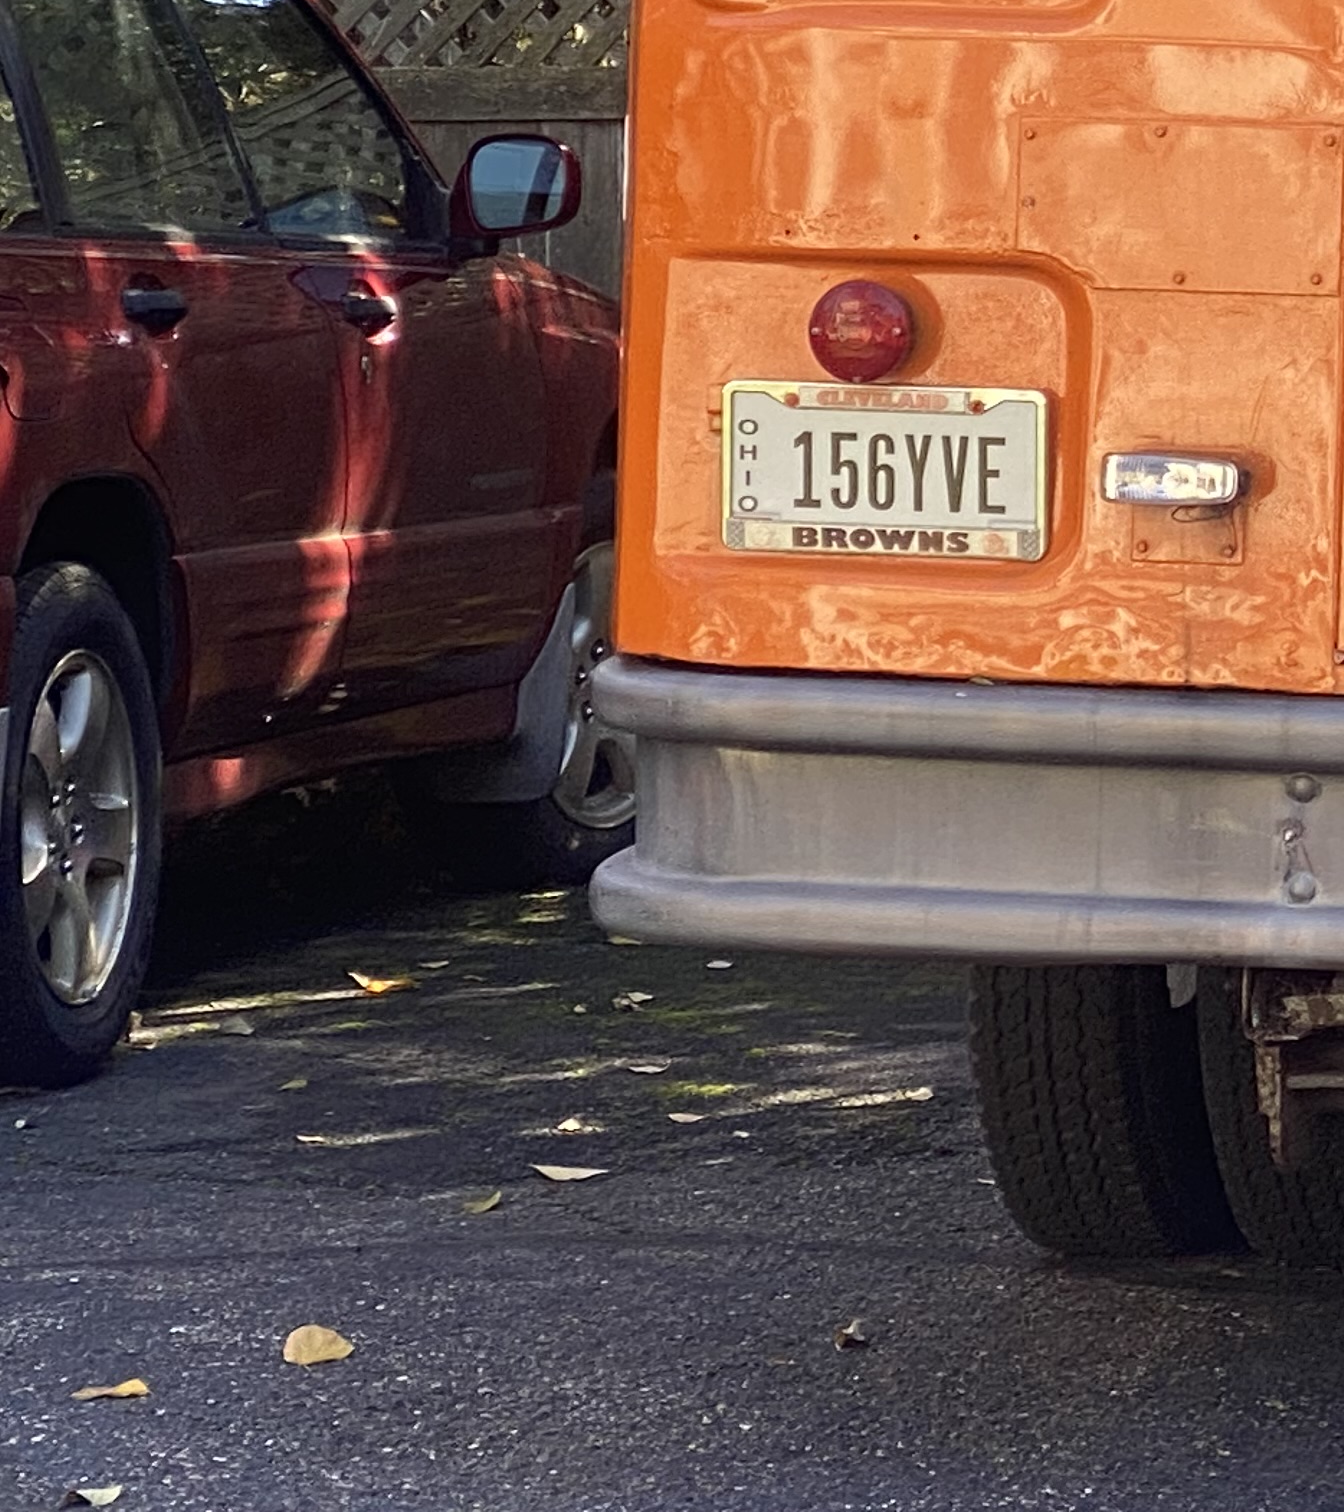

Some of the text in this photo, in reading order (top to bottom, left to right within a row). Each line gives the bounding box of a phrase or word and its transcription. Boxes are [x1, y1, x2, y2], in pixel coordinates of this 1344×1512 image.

[816, 389, 949, 410] CLEVELAND
[738, 419, 759, 513] OHIO
[793, 431, 1006, 515] 156YVE
[792, 526, 970, 554] BROWNS
